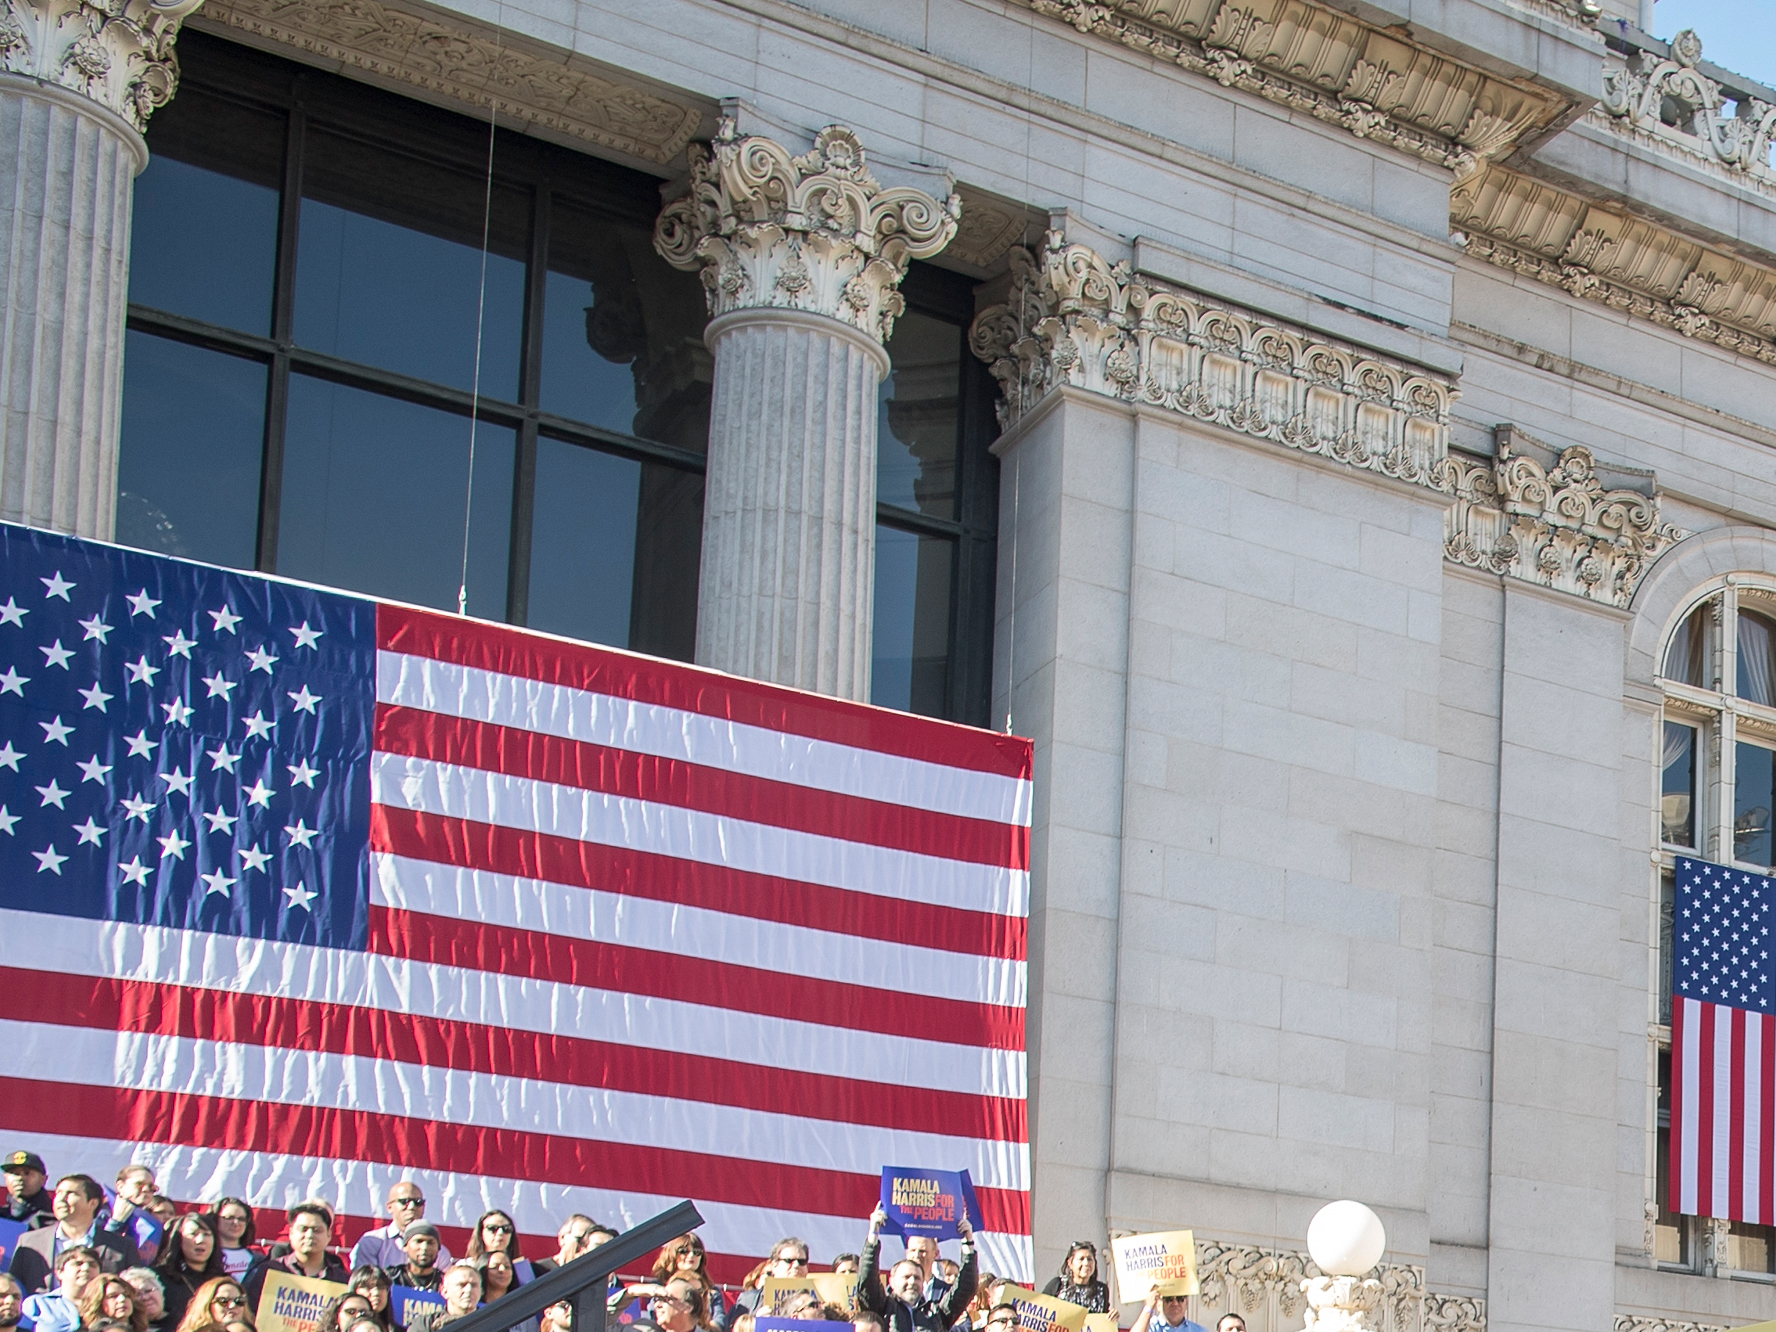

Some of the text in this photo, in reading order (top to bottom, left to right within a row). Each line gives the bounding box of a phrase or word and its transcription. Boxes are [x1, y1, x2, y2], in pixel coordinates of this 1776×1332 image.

[893, 1177, 940, 1194] KAMALA
[891, 1190, 954, 1208] HARRIS FOR
[914, 1206, 955, 1222] PEOPLE
[1124, 1244, 1168, 1259] KAMALA
[1126, 1254, 1185, 1271] HARRIS FOR
[1147, 1266, 1186, 1279] PEOPLE
[403, 1298, 443, 1316] KAMA
[1011, 1297, 1057, 1322] KAMALA
[1018, 1314, 1049, 1332] RRIS
